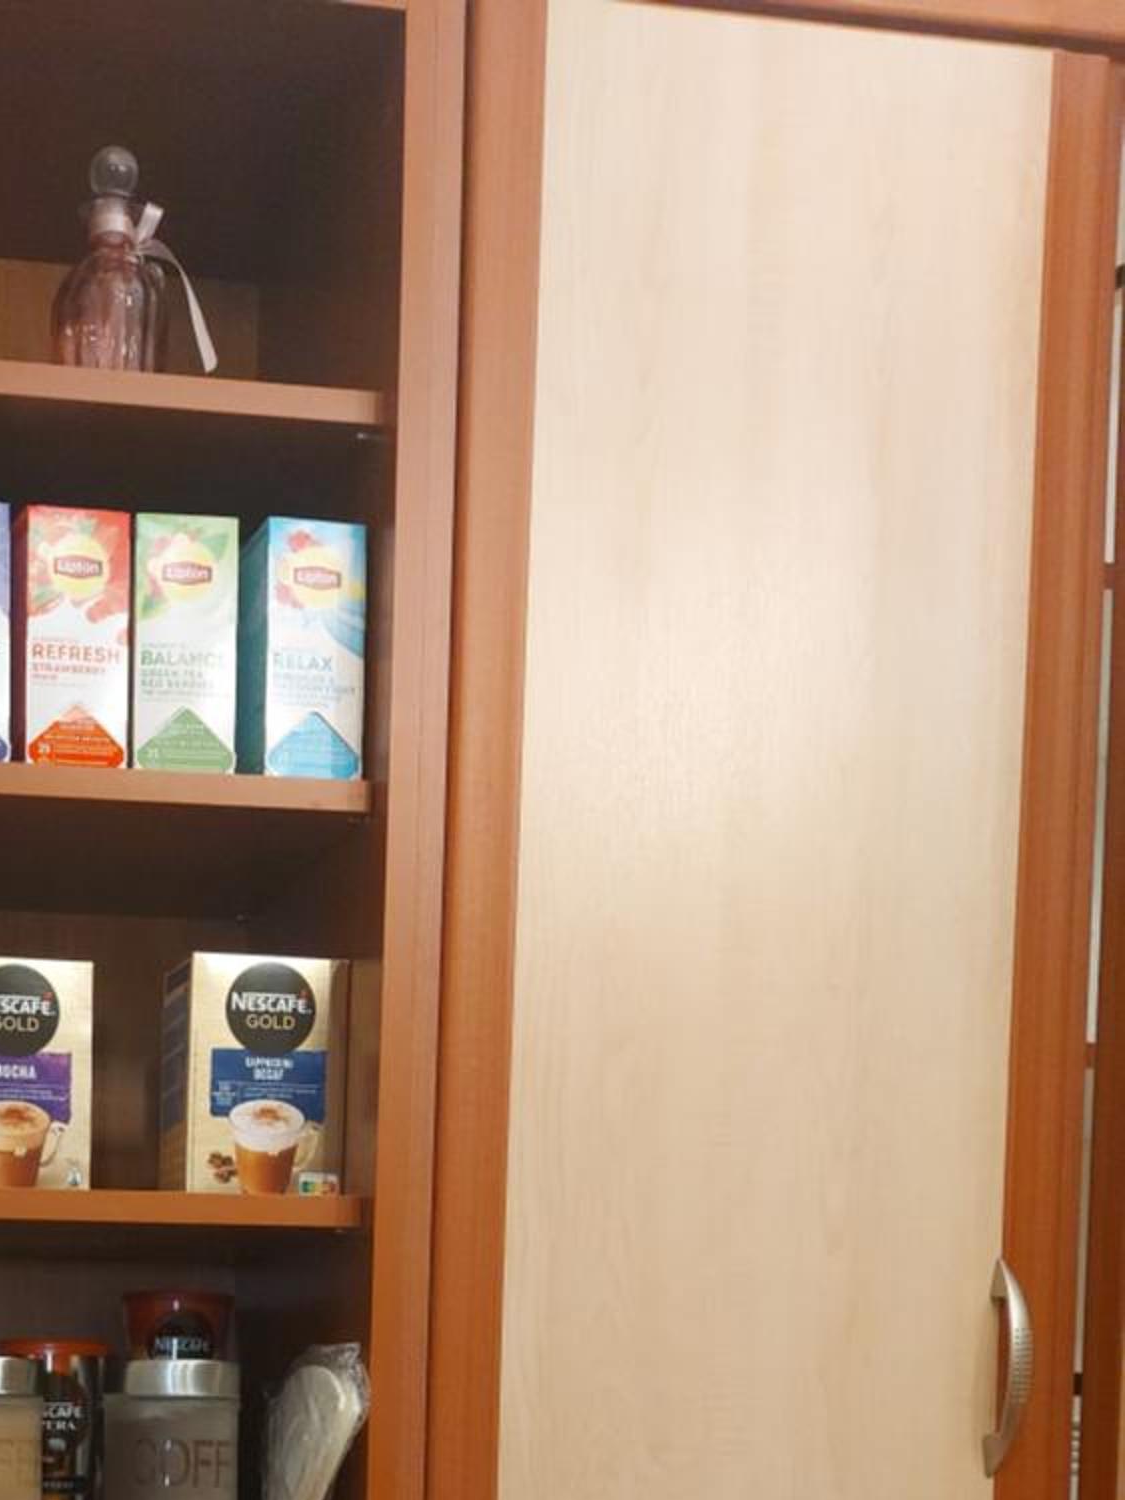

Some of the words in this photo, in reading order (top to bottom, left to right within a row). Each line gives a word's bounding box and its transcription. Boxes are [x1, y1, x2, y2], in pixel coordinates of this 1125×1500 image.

[58, 559, 99, 576] Lipton
[32, 643, 120, 664] REFRESH
[273, 652, 333, 672] RELAX
[246, 1014, 296, 1031] GOLD
[135, 1437, 232, 1489] COFF
